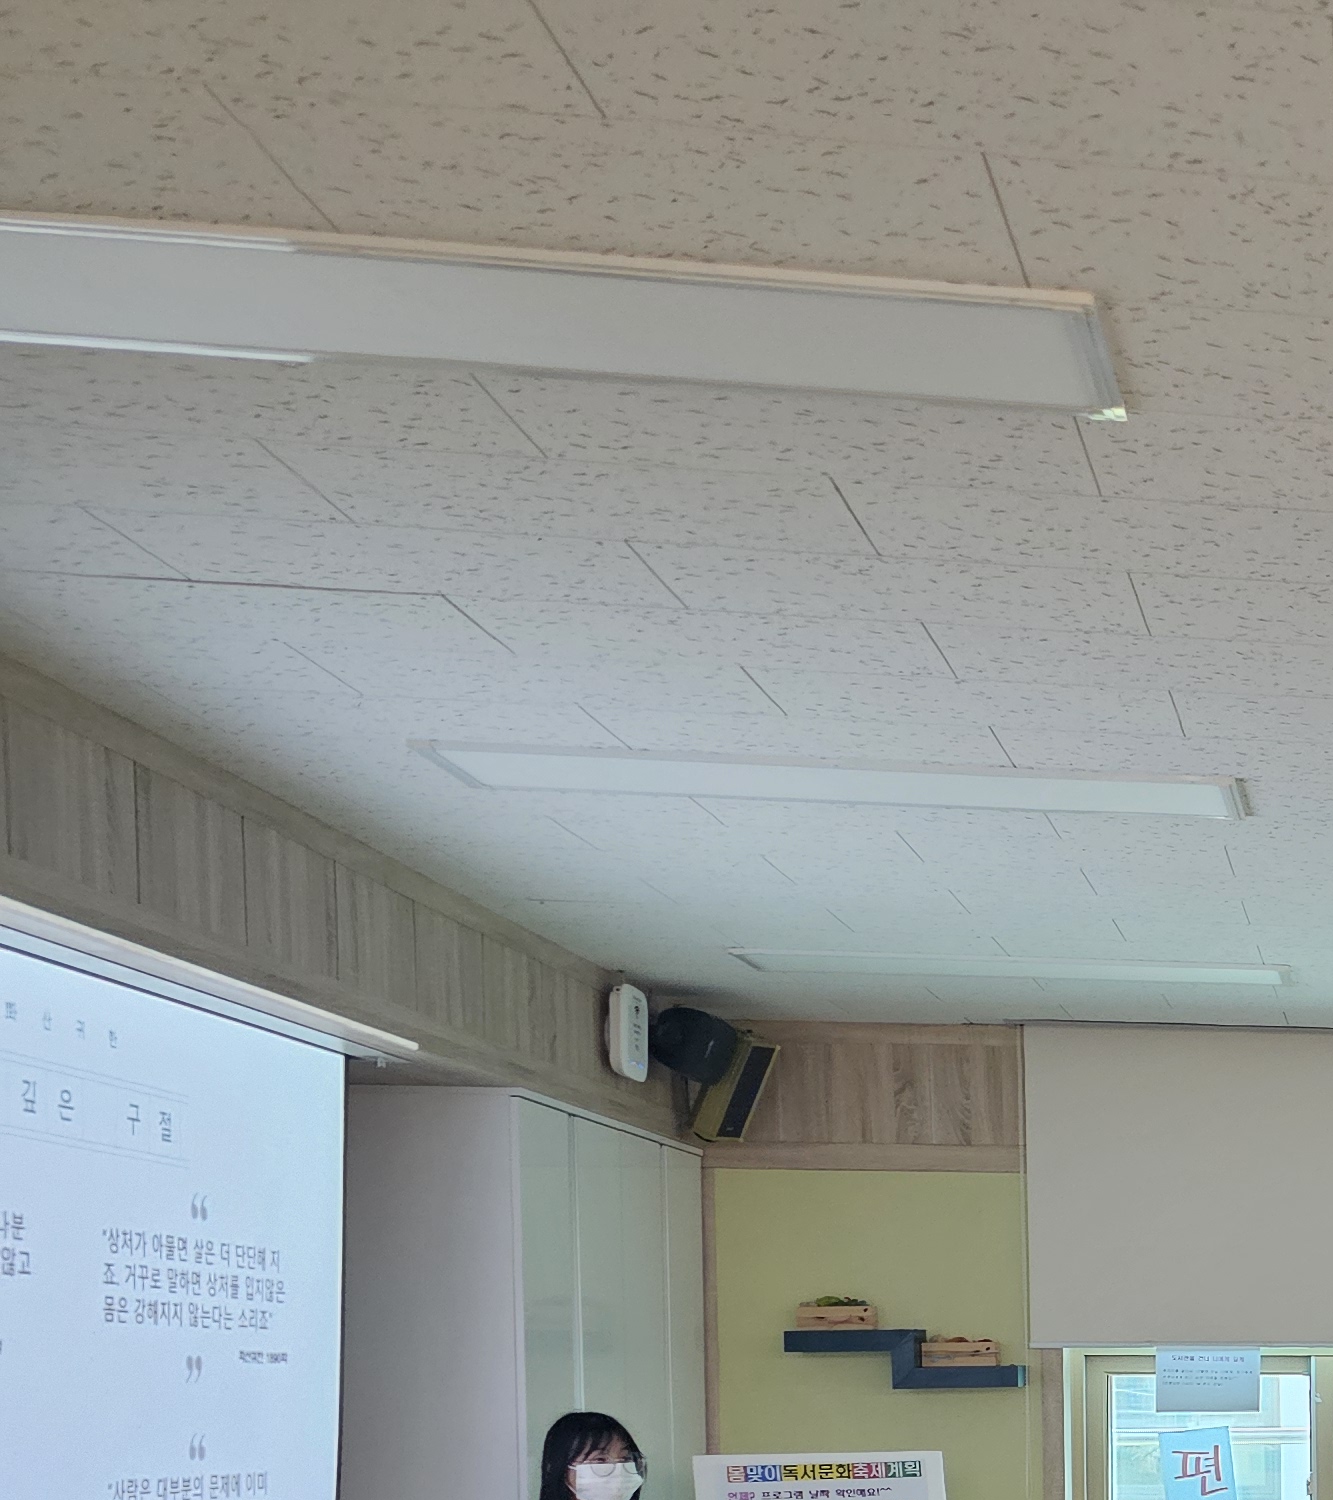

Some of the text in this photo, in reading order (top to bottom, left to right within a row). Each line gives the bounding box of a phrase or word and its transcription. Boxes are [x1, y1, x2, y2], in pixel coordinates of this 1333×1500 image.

[126, 1103, 172, 1142] 구절
[152, 1232, 188, 1263] 아물면
[219, 1242, 231, 1268] 더
[124, 1263, 162, 1291] 거꾸로
[166, 1267, 202, 1296] 말하면
[103, 1295, 129, 1324] 몸은
[134, 1297, 184, 1327] 강해지지
[246, 1471, 268, 1496] 이미
[1171, 1444, 1229, 1496] 편
